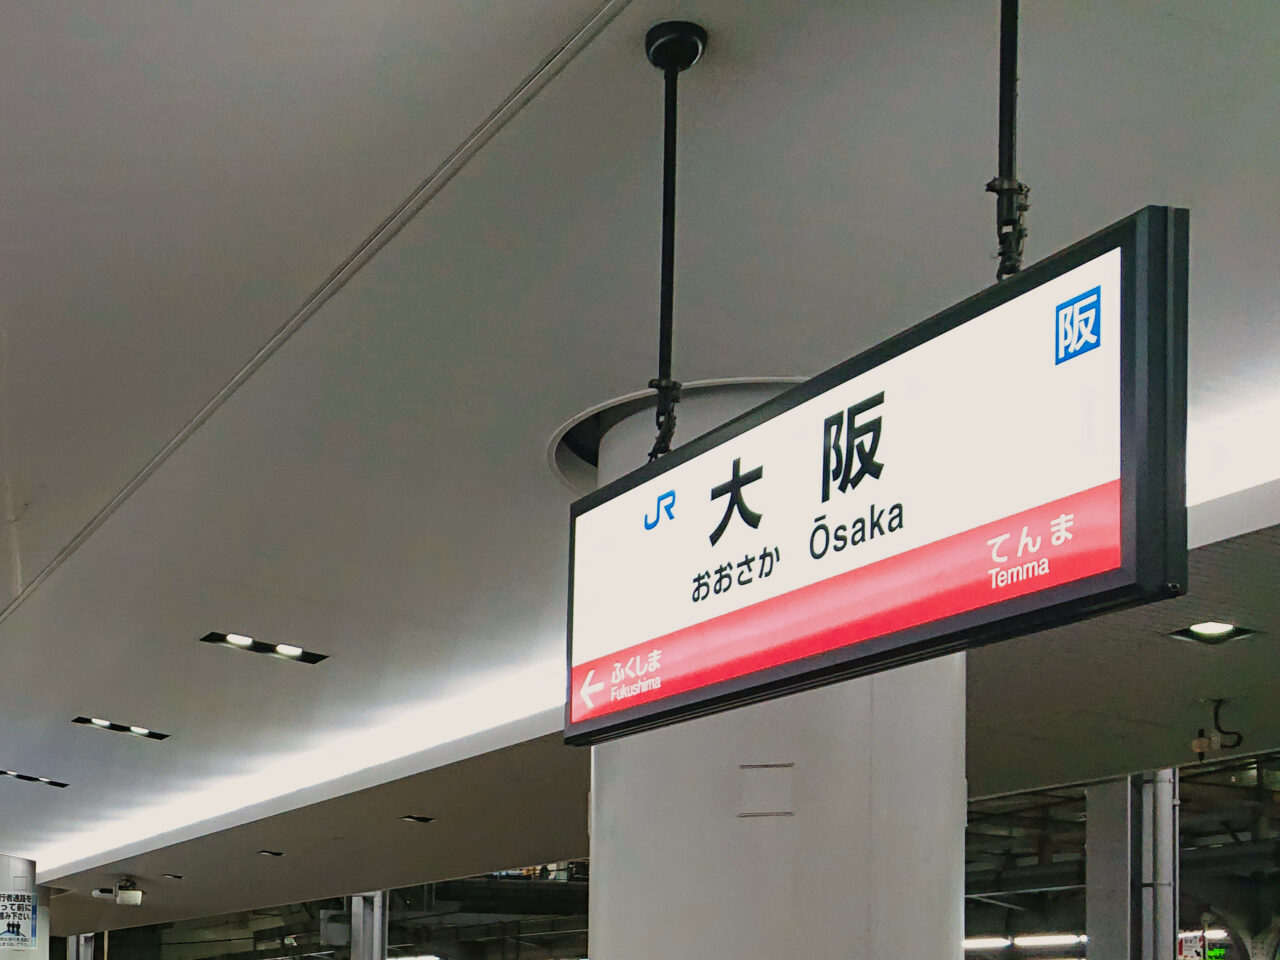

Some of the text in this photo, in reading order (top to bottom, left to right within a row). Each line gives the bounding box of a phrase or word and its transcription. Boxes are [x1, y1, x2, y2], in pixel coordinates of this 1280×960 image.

[1058, 293, 1098, 360] 阪
[709, 390, 885, 547] 大阪
[644, 489, 676, 530] JR
[809, 502, 904, 560] Ōsaka
[987, 513, 1074, 563] てんま
[692, 546, 781, 602] おおさか
[988, 557, 1050, 589] Temma
[611, 649, 662, 684] ふくしま
[611, 676, 662, 702] Fukushima
